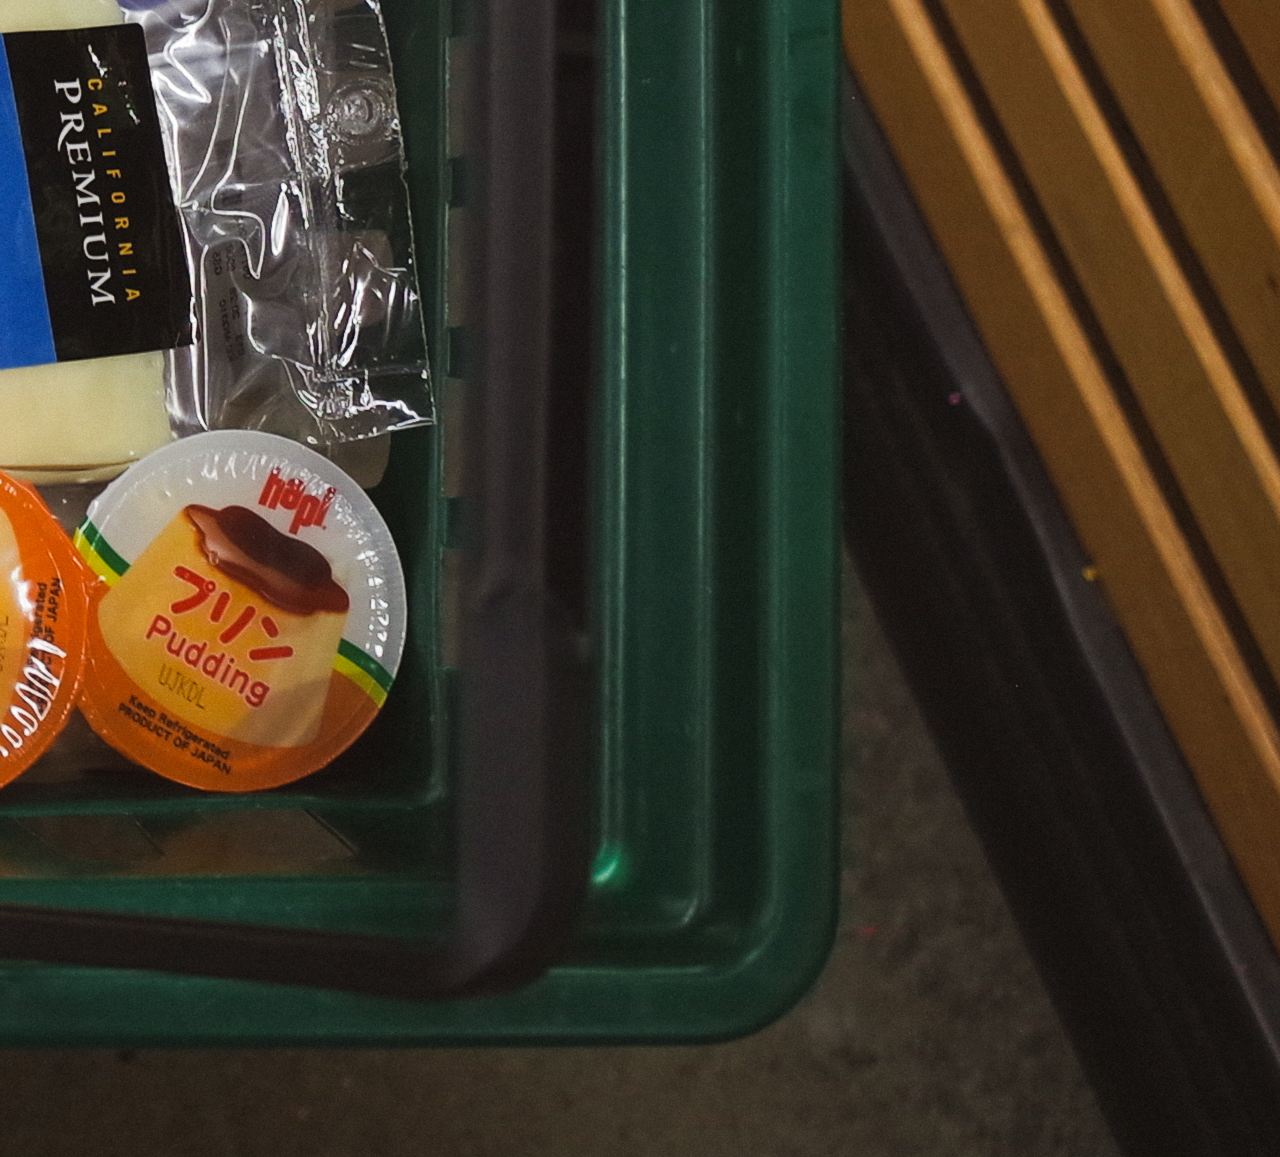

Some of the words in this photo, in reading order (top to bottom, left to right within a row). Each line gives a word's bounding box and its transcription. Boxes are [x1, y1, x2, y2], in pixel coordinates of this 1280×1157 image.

[54, 78, 116, 307] PREMIUM
[87, 78, 141, 302] CALIFORNIA
[258, 466, 337, 536] hapi
[46, 577, 62, 623] JAPAN
[170, 565, 295, 662] プリン
[145, 614, 272, 708] Pudding
[118, 702, 172, 741] PRODUCT
[173, 736, 190, 750] OF
[191, 747, 232, 775] JAPAN
[129, 694, 156, 719] Keep
[158, 712, 231, 761] Refrigerated
